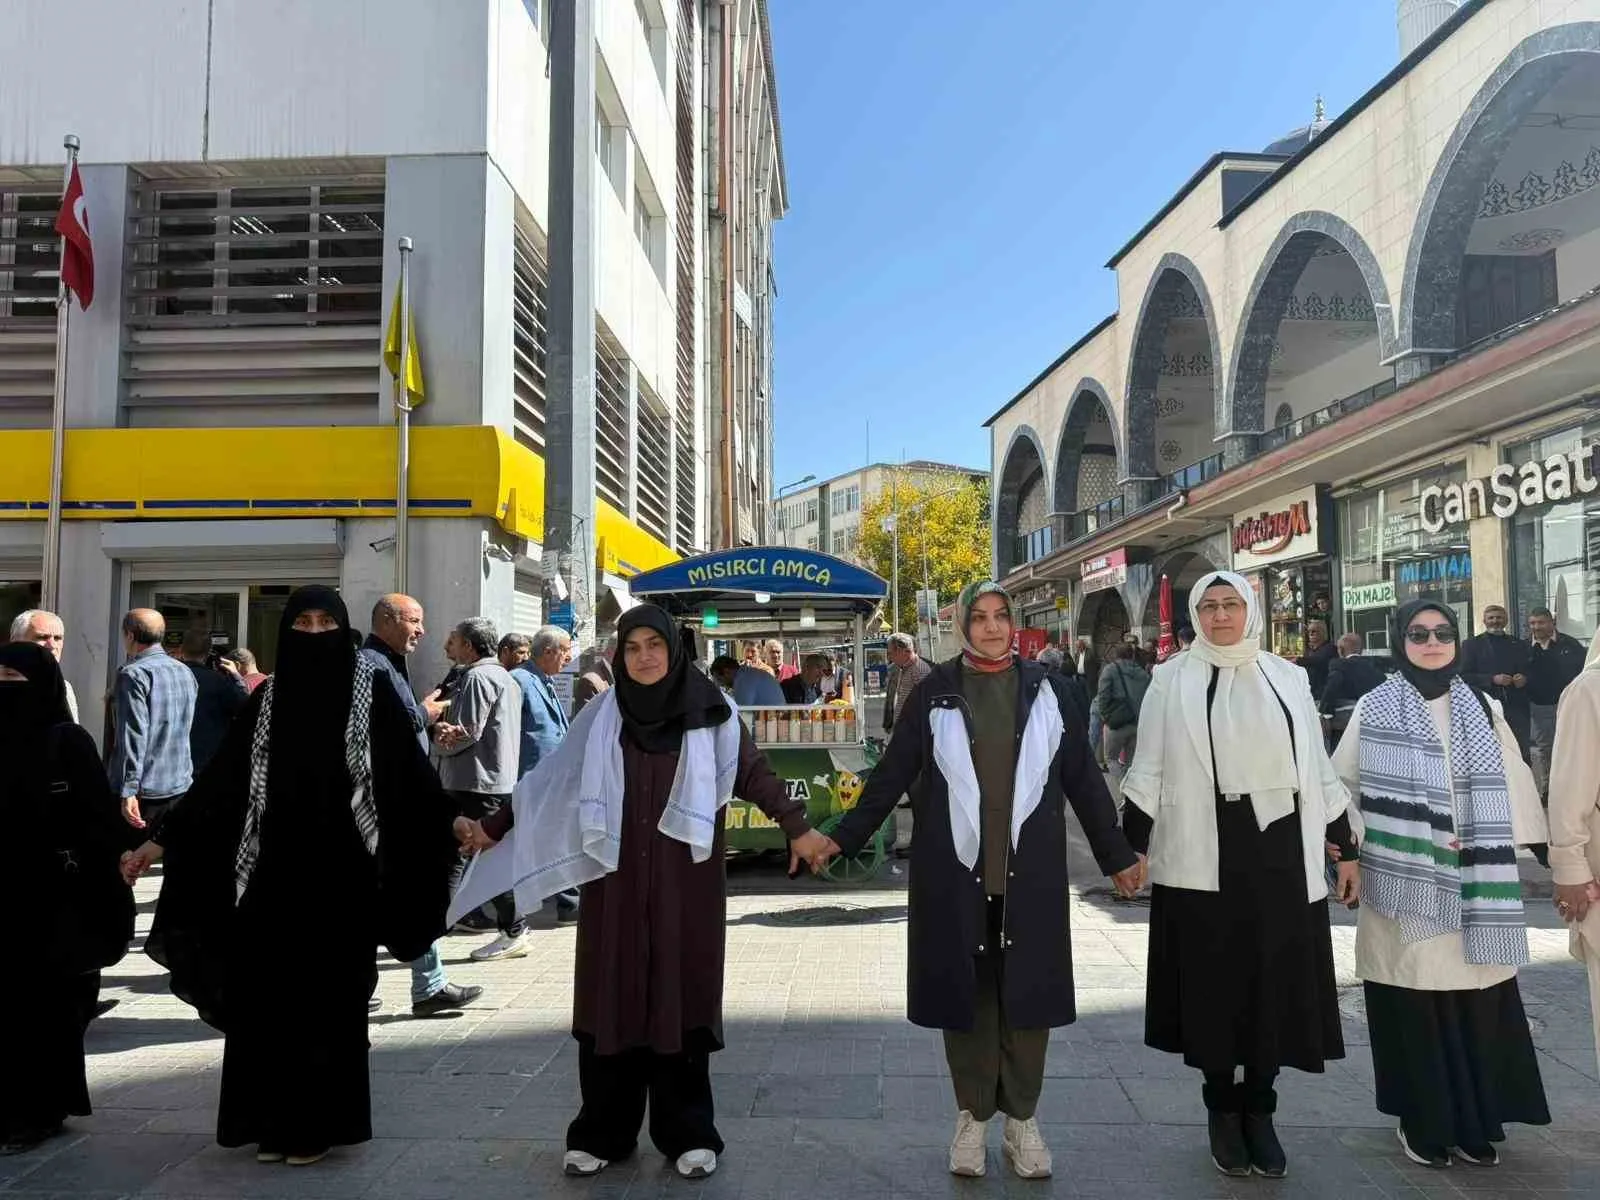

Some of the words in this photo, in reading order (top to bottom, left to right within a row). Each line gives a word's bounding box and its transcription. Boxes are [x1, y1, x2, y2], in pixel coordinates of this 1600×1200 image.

[1420, 482, 1487, 534] Can
[1491, 439, 1598, 519] Saat
[688, 558, 765, 585] MISIRCI
[772, 559, 831, 587] AMCA
